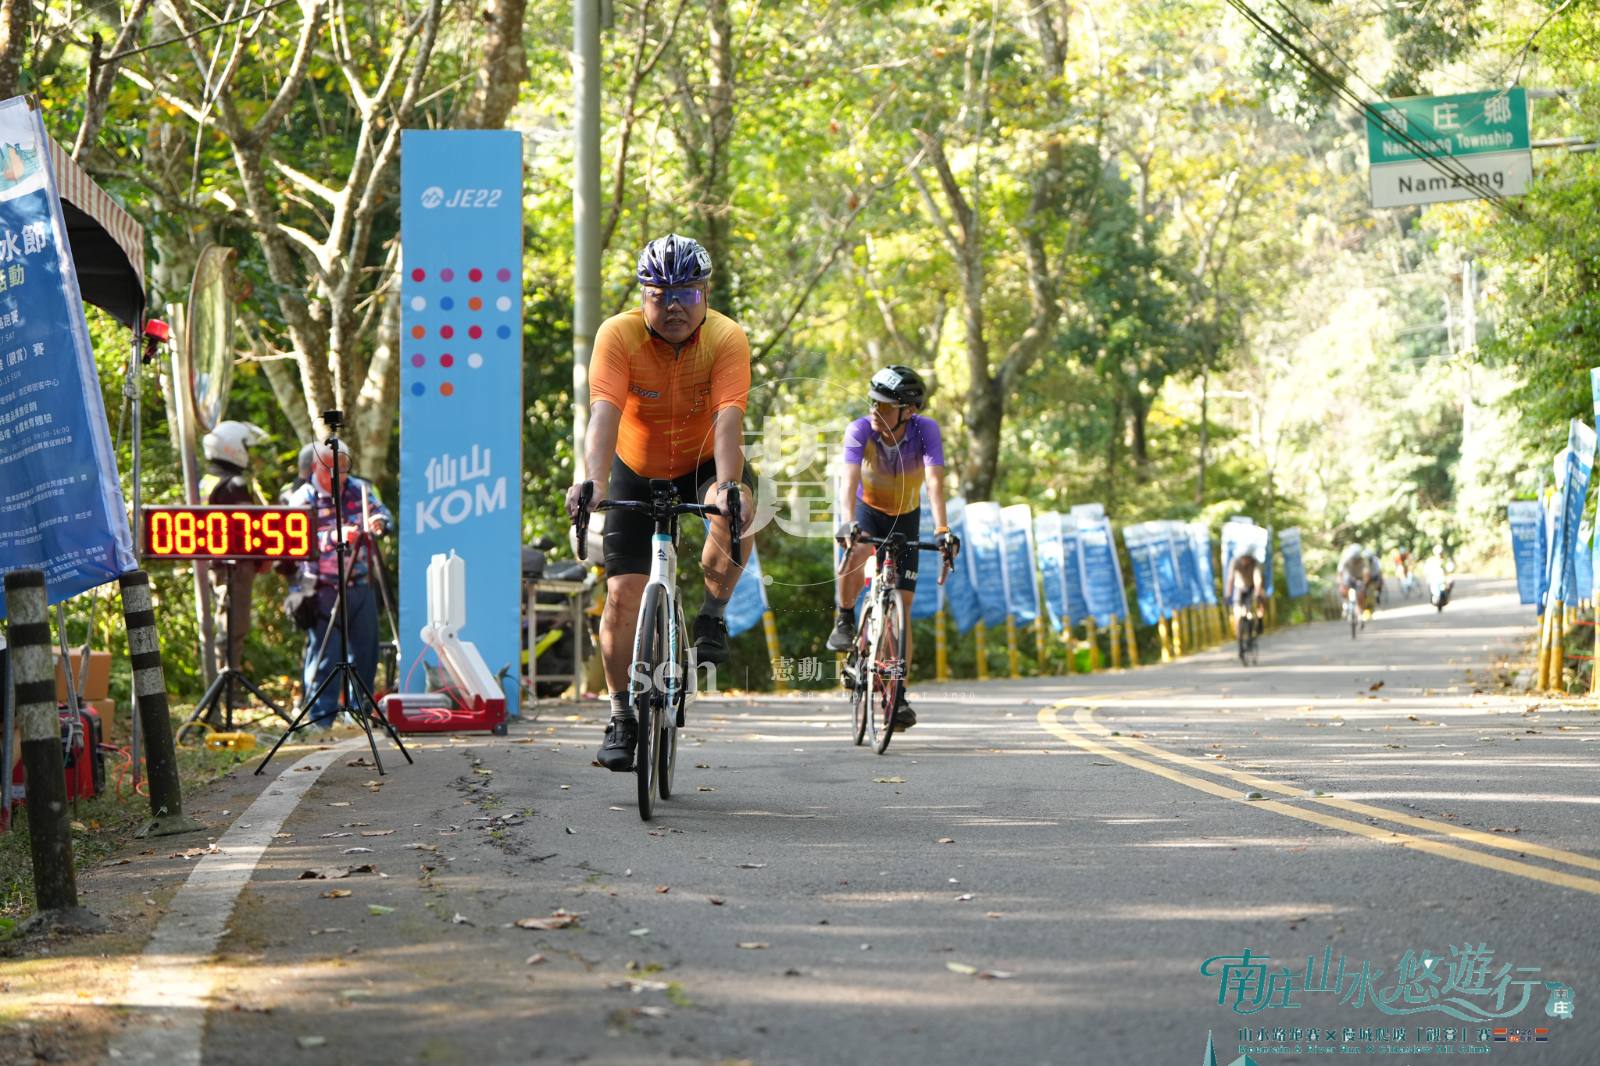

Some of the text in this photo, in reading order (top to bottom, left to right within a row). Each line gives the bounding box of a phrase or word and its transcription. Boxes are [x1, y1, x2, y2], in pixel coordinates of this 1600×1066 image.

[1381, 96, 1512, 136] 南庄鄉
[1456, 130, 1513, 148] Township
[445, 189, 503, 208] JE22
[425, 444, 491, 493] 仙山
[416, 477, 507, 534] KOM
[152, 512, 308, 555] 08:07:59
